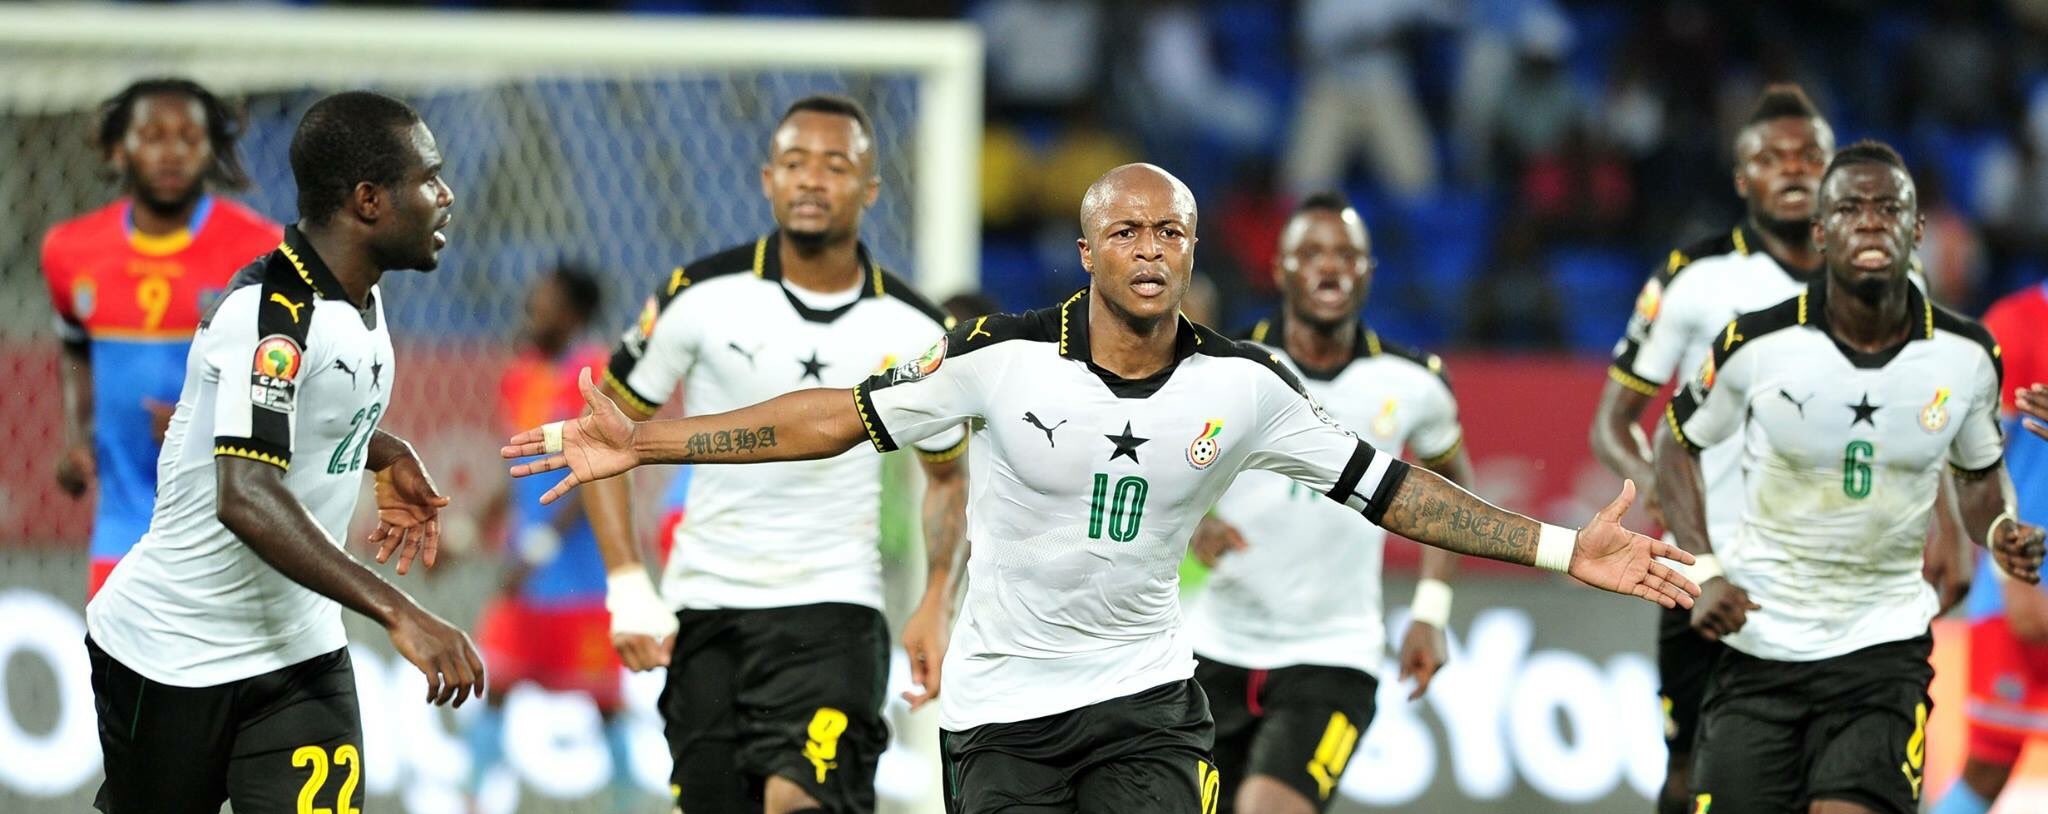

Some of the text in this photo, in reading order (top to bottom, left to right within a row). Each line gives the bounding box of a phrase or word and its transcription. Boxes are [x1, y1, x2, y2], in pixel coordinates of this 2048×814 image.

[137, 274, 171, 331] 9
[326, 403, 381, 474] 22
[685, 426, 777, 458] MAHA
[1843, 441, 1873, 500] 6
[1088, 473, 1149, 542] 10
[292, 745, 360, 814] 22
